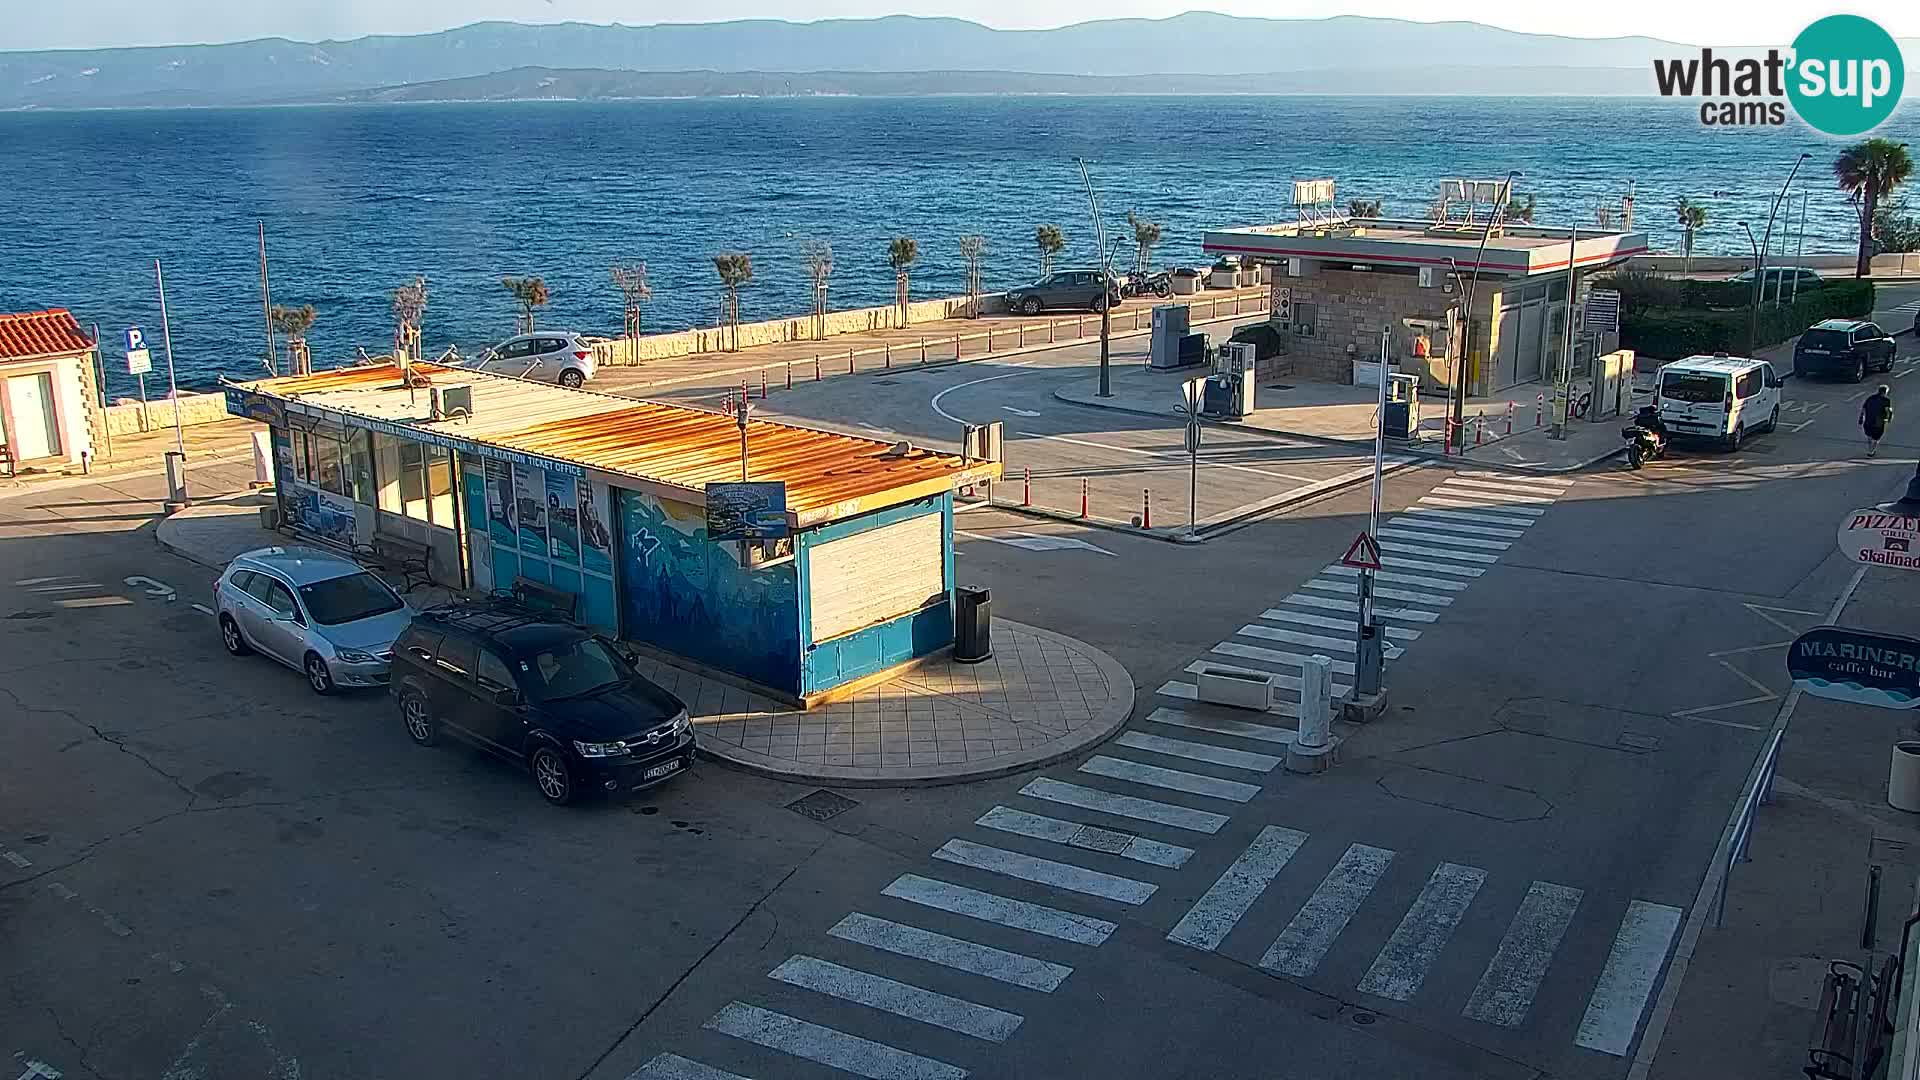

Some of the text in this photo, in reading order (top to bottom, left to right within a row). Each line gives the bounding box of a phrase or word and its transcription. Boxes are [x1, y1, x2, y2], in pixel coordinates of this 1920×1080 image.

[129, 330, 142, 348] P
[478, 446, 493, 457] BUS
[493, 448, 525, 464] STATION
[528, 456, 553, 471] TICKET
[555, 463, 582, 476] OFFICE
[1881, 529, 1916, 540] GRILL
[1828, 662, 1896, 679] caffe bar
